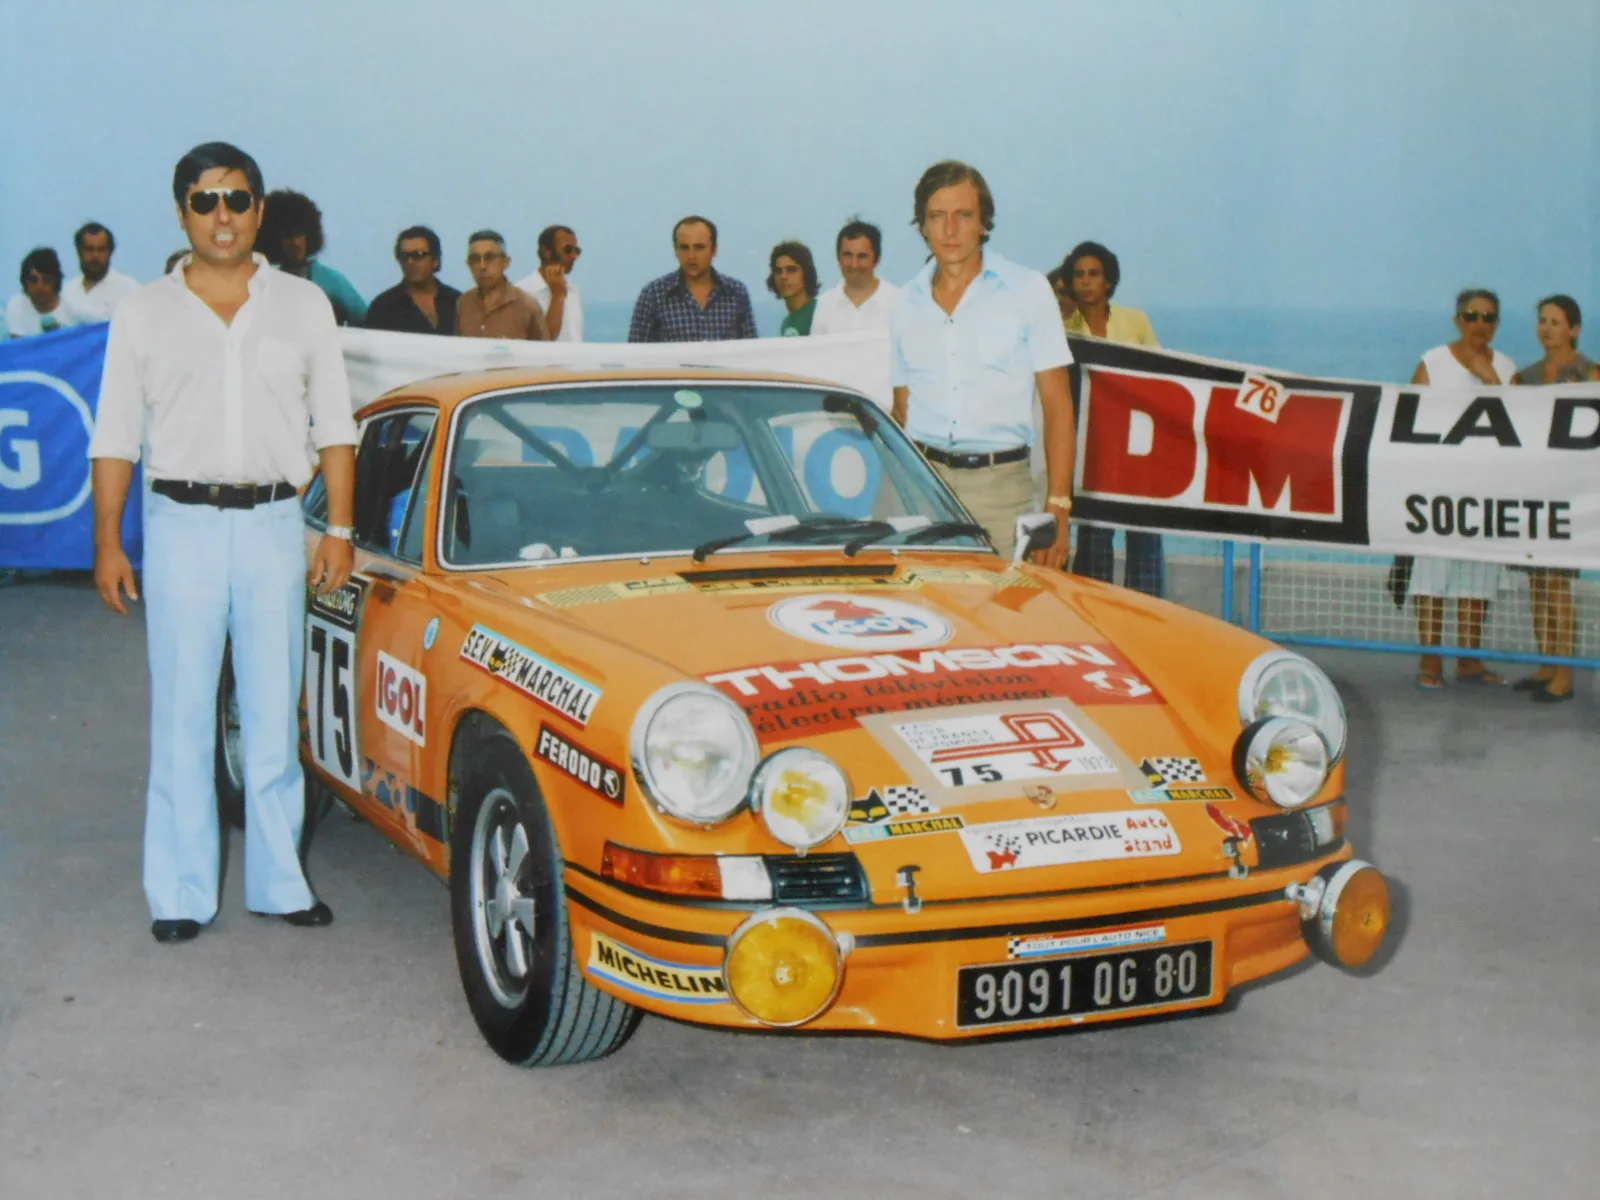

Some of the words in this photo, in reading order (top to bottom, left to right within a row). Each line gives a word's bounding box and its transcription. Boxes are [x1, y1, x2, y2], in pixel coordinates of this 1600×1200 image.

[1240, 378, 1278, 415] 76
[1389, 393, 1523, 448] LA
[1082, 369, 1344, 515] DM
[1405, 494, 1571, 540] SOCIETE
[515, 657, 594, 722] MARCHAL
[704, 642, 1117, 697] THOMSON
[743, 689, 849, 717] radio
[863, 672, 1038, 698] télévision
[311, 624, 353, 779] 75
[378, 660, 425, 737] IGOL
[538, 730, 602, 790] FERODO
[940, 763, 1004, 787] 75
[1169, 789, 1230, 801] MARCHAL
[888, 817, 962, 836] MARCHAL
[1025, 823, 1124, 847] PICARDIE
[1125, 815, 1170, 831] Auto
[597, 940, 727, 993] MICHELIN
[975, 964, 1073, 1021] 9091
[1093, 957, 1138, 1007] QG
[1153, 949, 1198, 999] 80
